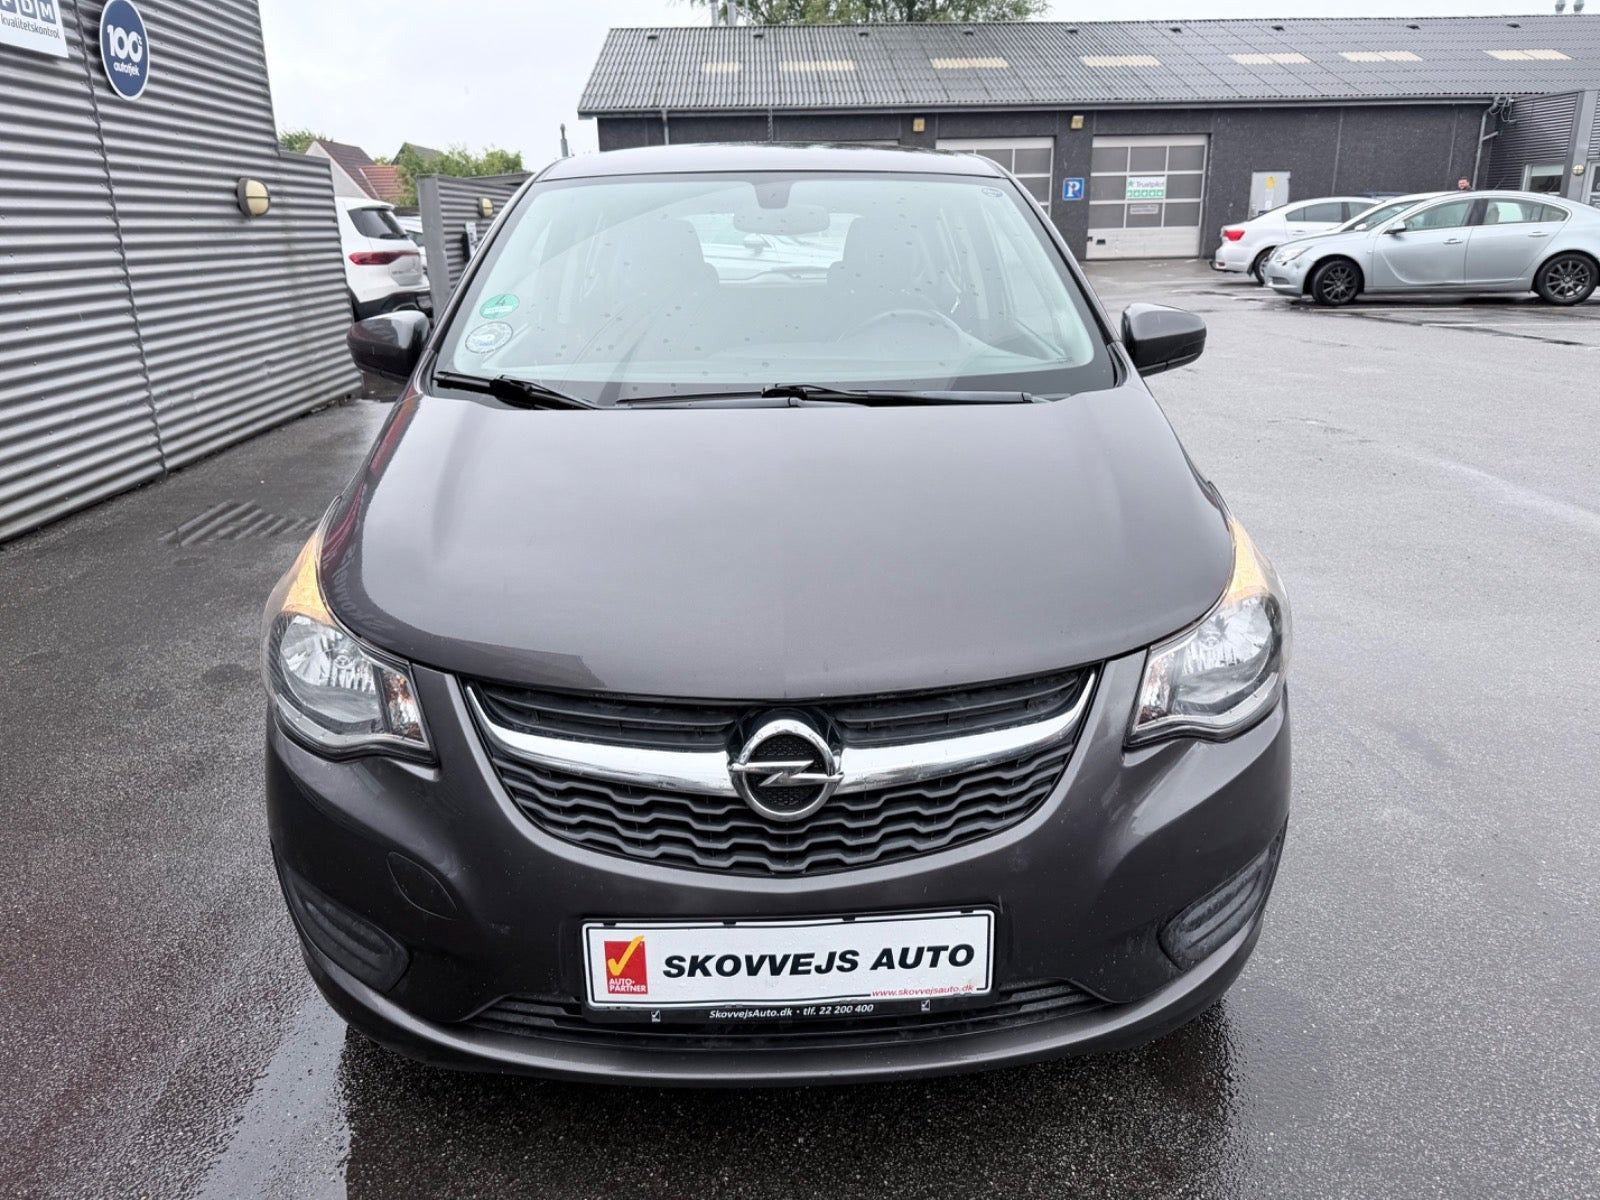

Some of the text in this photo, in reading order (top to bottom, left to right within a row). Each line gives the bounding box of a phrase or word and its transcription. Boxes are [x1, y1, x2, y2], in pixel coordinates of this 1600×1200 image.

[0, 13, 60, 39] kvalitetskontrol
[662, 943, 975, 979] SKOVVEJS AUTO
[609, 984, 647, 993] PARTNER
[871, 984, 974, 998] www.skovvejsauto.dk
[708, 1004, 874, 1020] SkovvejsAuto.dk tlf. 22 200 400
